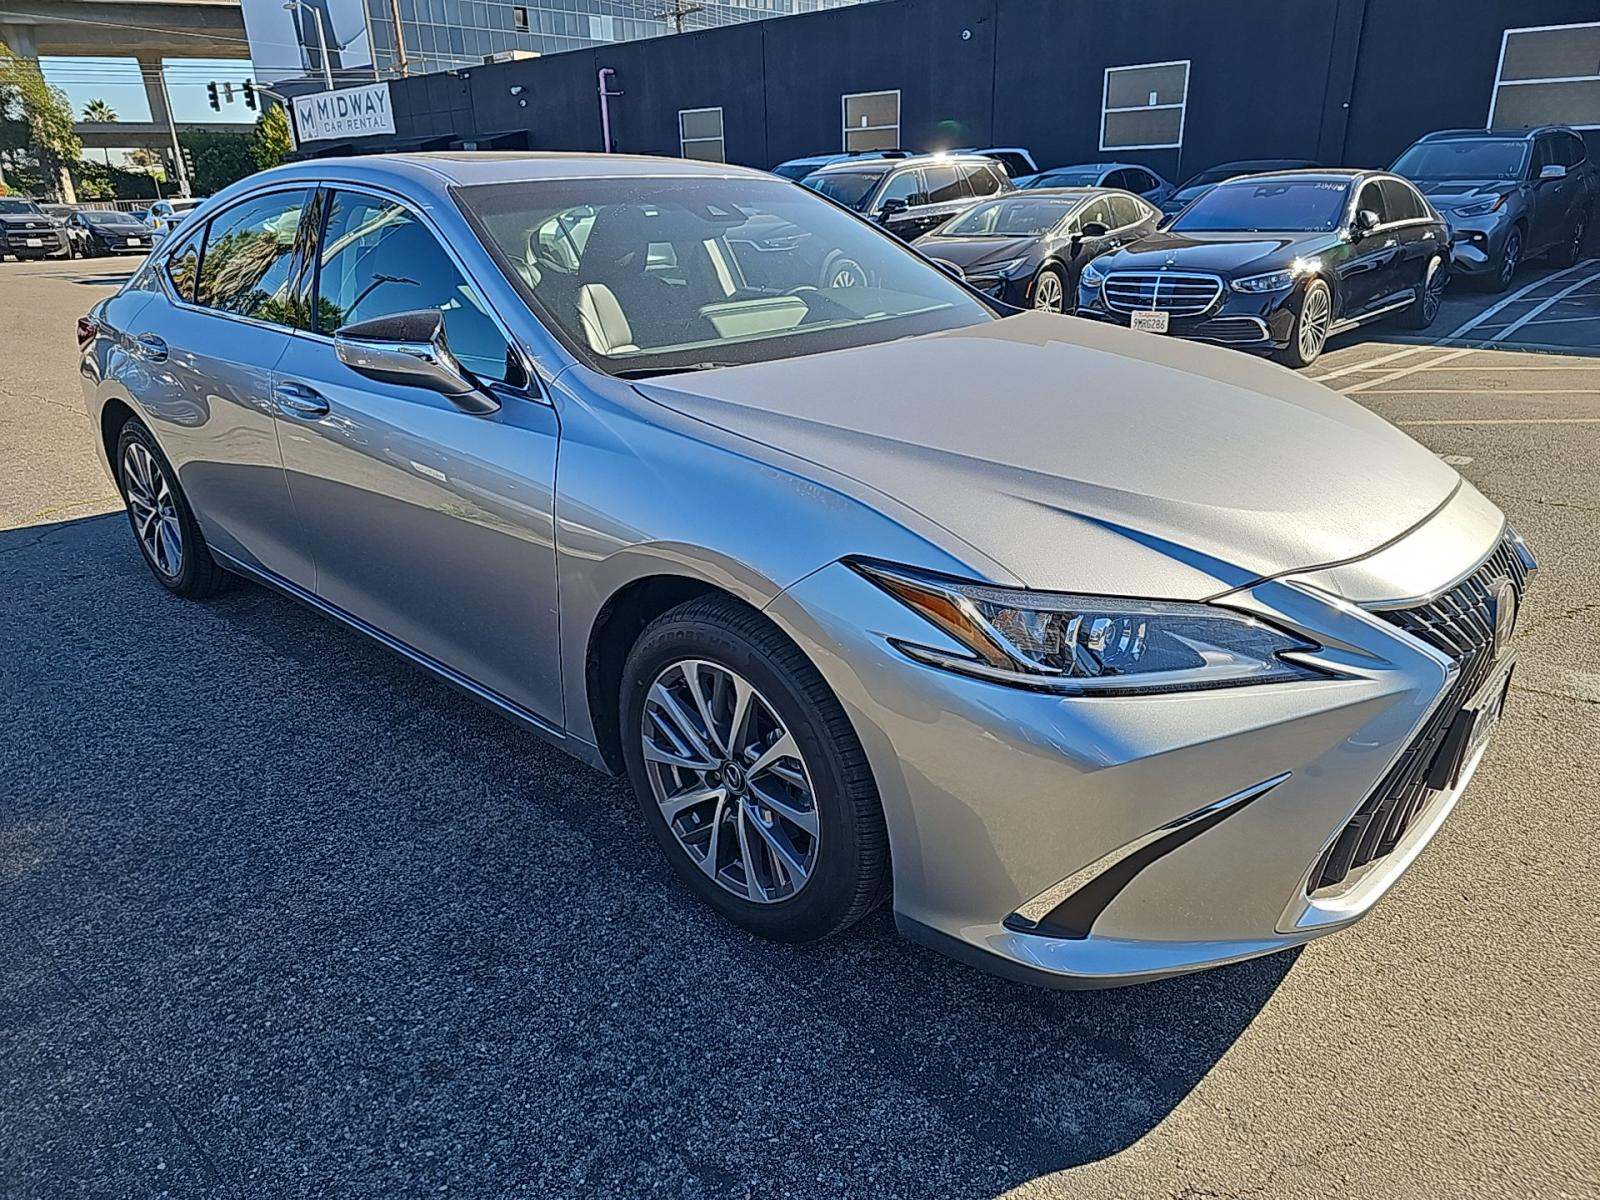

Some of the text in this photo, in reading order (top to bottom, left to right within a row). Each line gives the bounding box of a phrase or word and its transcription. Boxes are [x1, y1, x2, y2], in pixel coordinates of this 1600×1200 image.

[317, 90, 385, 120] MIDWAY
[299, 107, 315, 131] M
[324, 117, 386, 133] CAR RENTAL
